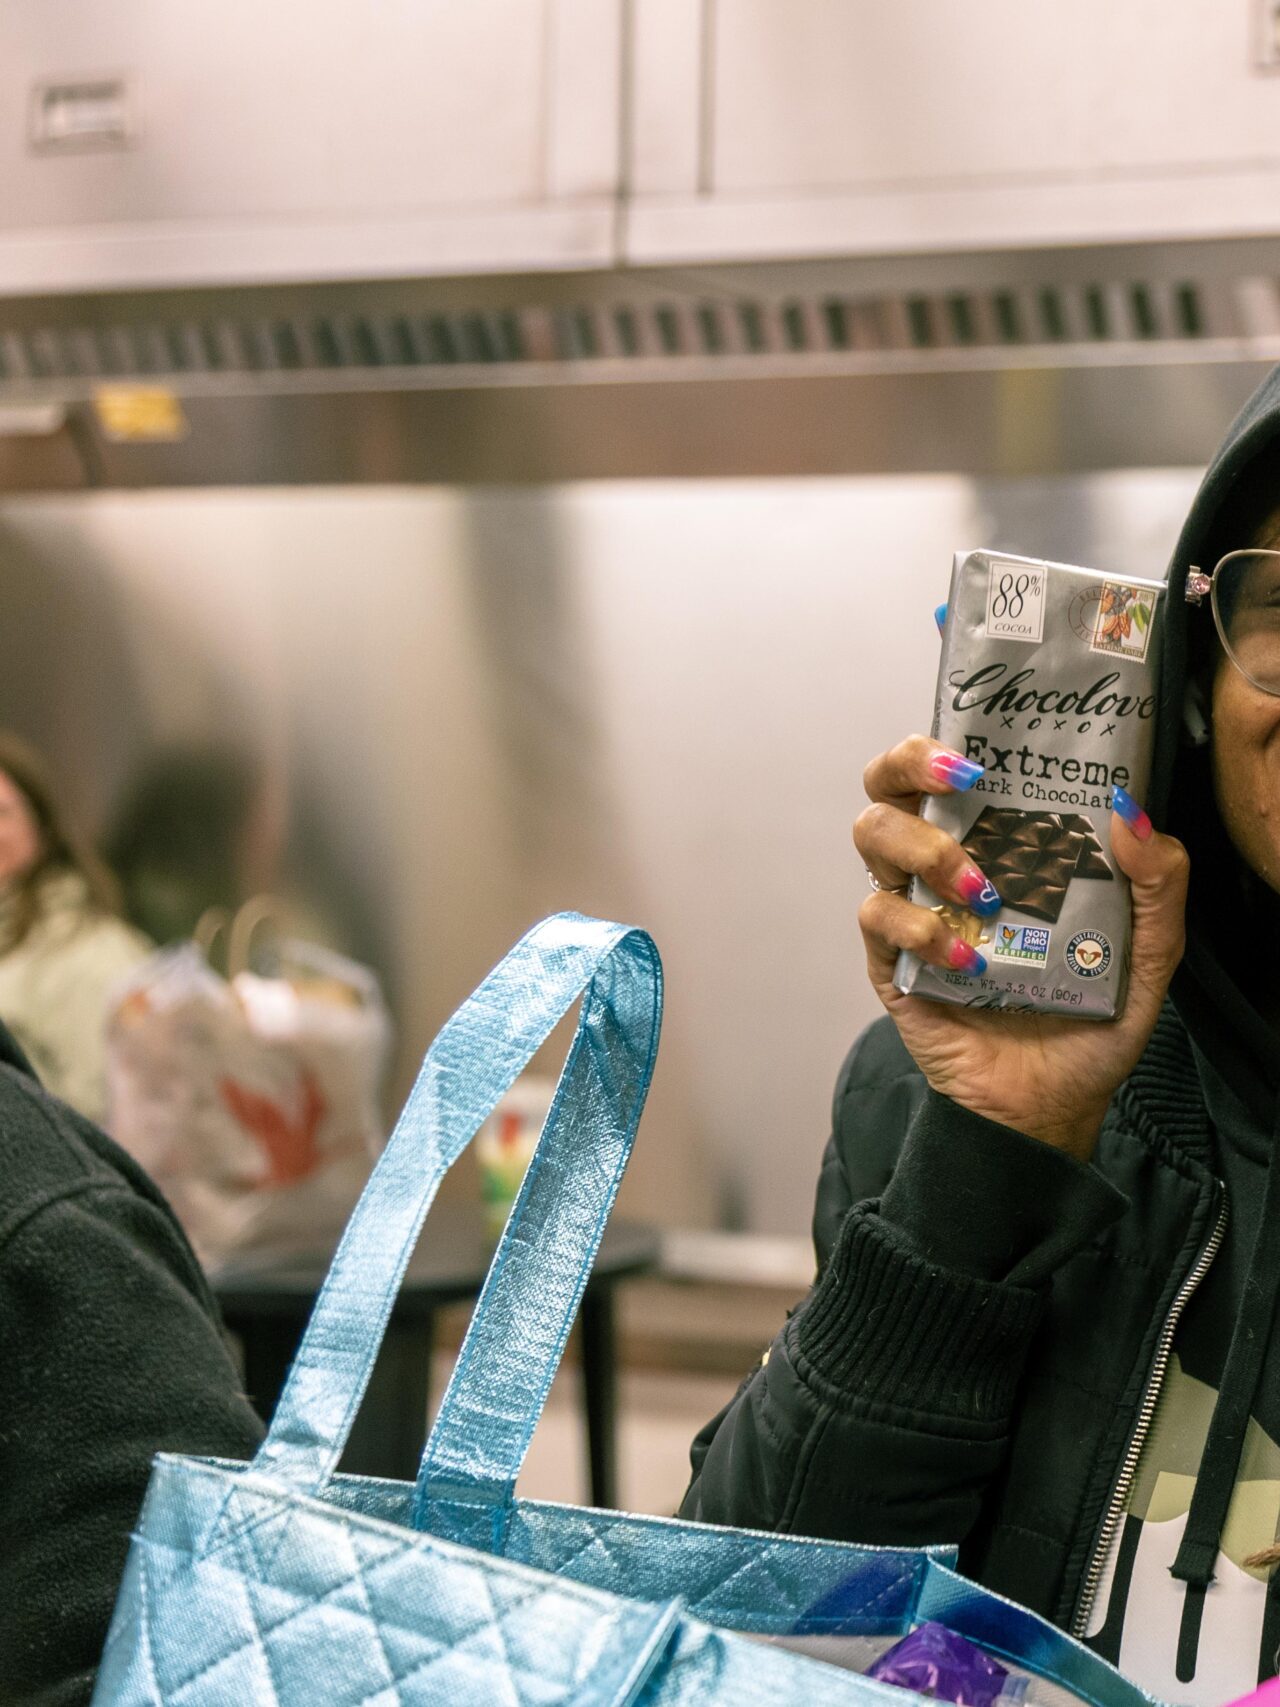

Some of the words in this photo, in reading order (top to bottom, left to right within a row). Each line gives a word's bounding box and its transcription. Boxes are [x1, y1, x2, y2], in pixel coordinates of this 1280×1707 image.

[992, 573, 1041, 618] 88%
[995, 622, 1032, 634] COCOA
[949, 663, 1156, 719] Chocolove
[964, 735, 1130, 788] Extreme
[971, 778, 1012, 796] ark
[1022, 781, 1113, 810] Chocolat
[1024, 937, 1047, 946] GMO
[1025, 928, 1047, 938] NON
[1072, 932, 1108, 948] SUSTAINABLE
[997, 947, 1044, 960] VERIFIED
[980, 978, 999, 991] WT.
[1005, 982, 1025, 995] 3.2
[1051, 987, 1083, 1005] (90g)
